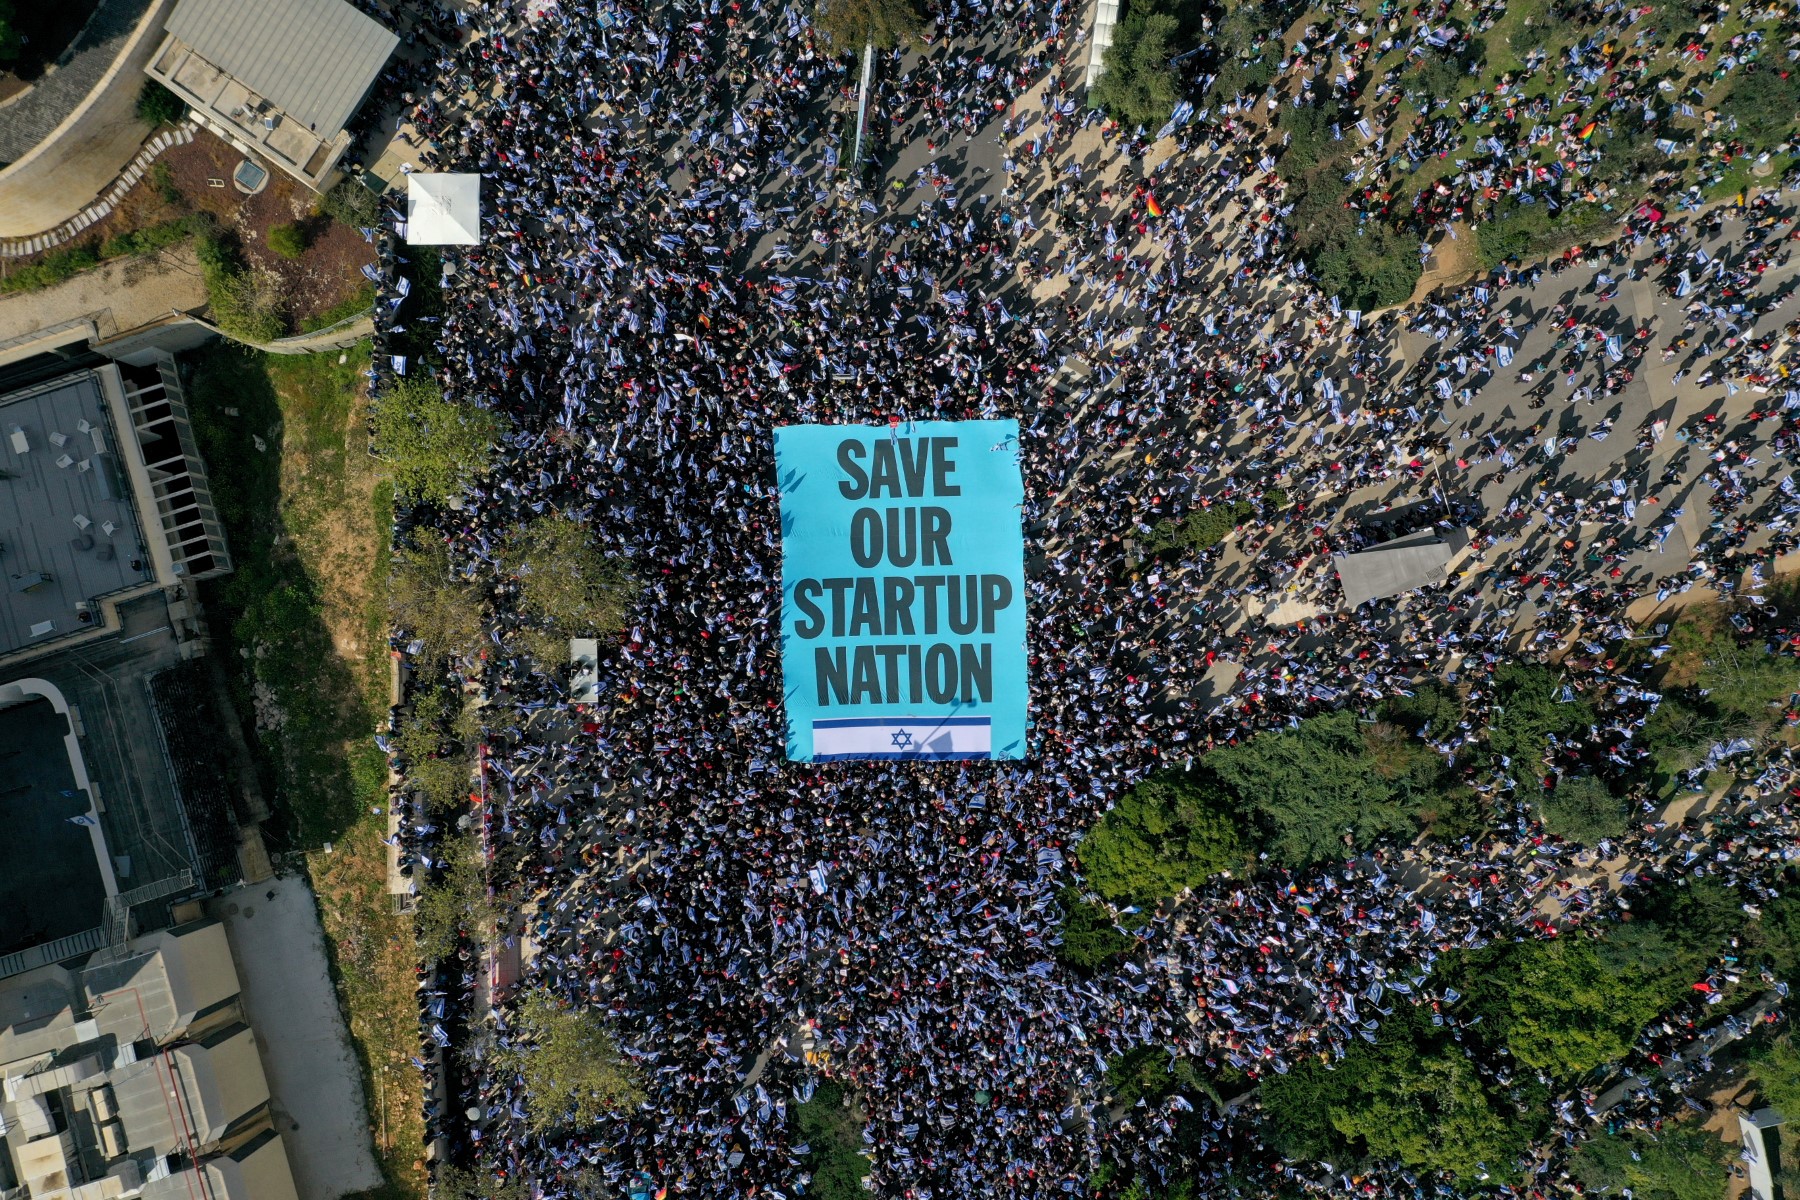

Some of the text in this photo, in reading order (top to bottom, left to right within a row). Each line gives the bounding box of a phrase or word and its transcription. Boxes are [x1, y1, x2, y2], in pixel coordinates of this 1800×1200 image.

[837, 437, 961, 500] SAVE
[850, 506, 953, 568] OUR
[794, 574, 1013, 639] STARTUP
[815, 643, 993, 706] NATION
